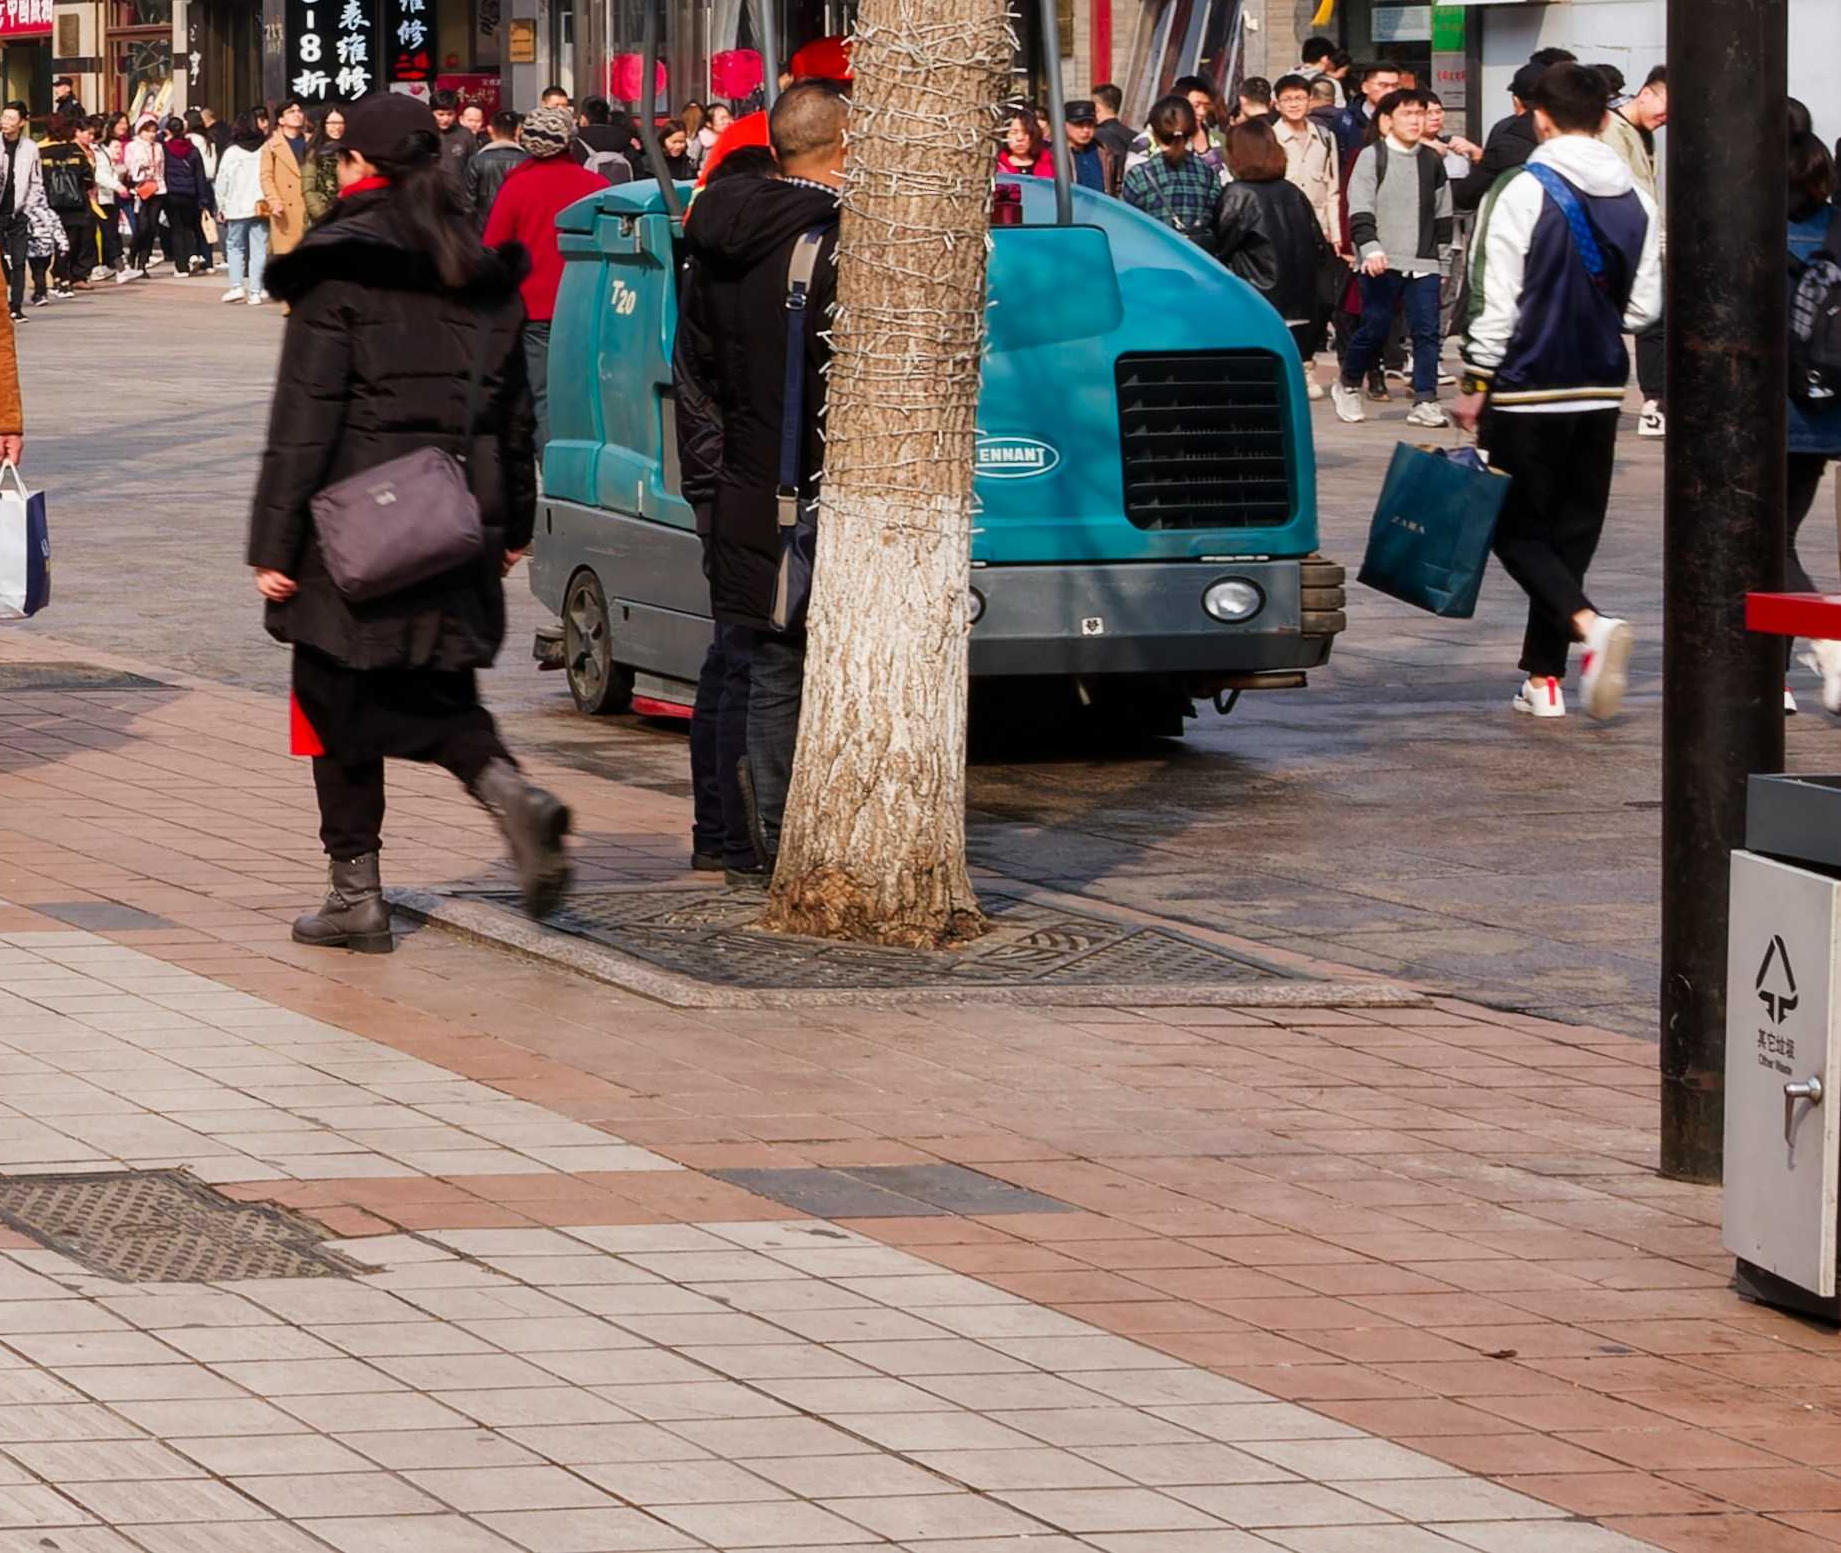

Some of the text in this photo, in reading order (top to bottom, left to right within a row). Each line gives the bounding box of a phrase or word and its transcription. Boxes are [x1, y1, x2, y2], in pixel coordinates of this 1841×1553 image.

[611, 280, 637, 315] T20
[978, 447, 1046, 466] ENNANT
[1757, 1028, 1796, 1061] 其它垃圾
